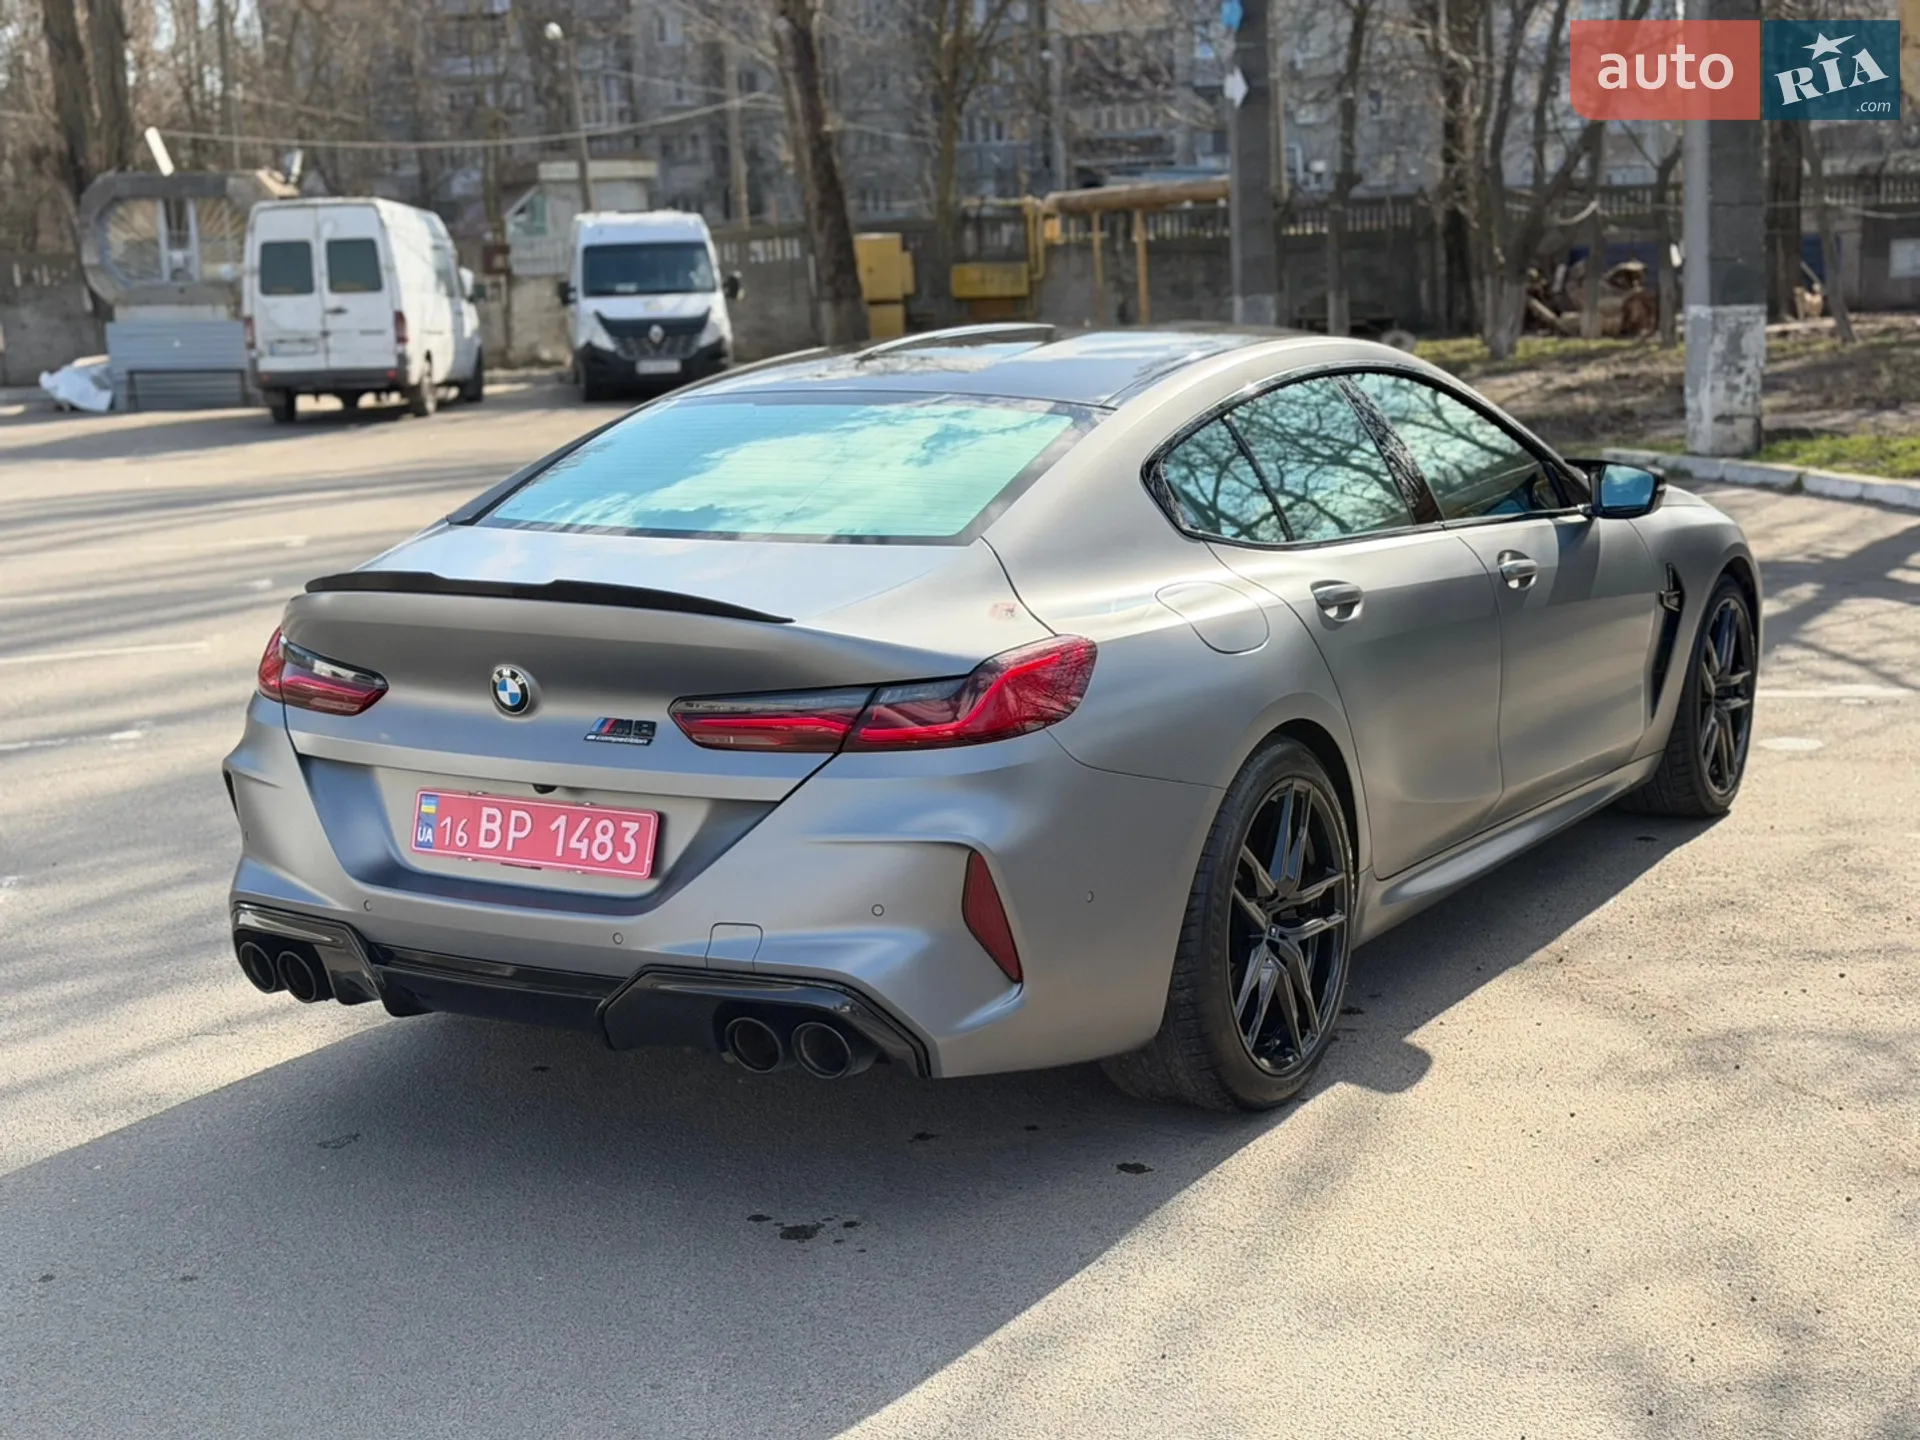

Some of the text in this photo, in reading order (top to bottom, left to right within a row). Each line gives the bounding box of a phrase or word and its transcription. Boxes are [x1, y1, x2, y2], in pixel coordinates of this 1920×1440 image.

[492, 668, 524, 685] BMW
[417, 826, 433, 843] UA
[440, 807, 640, 864] 16 BP 1483
